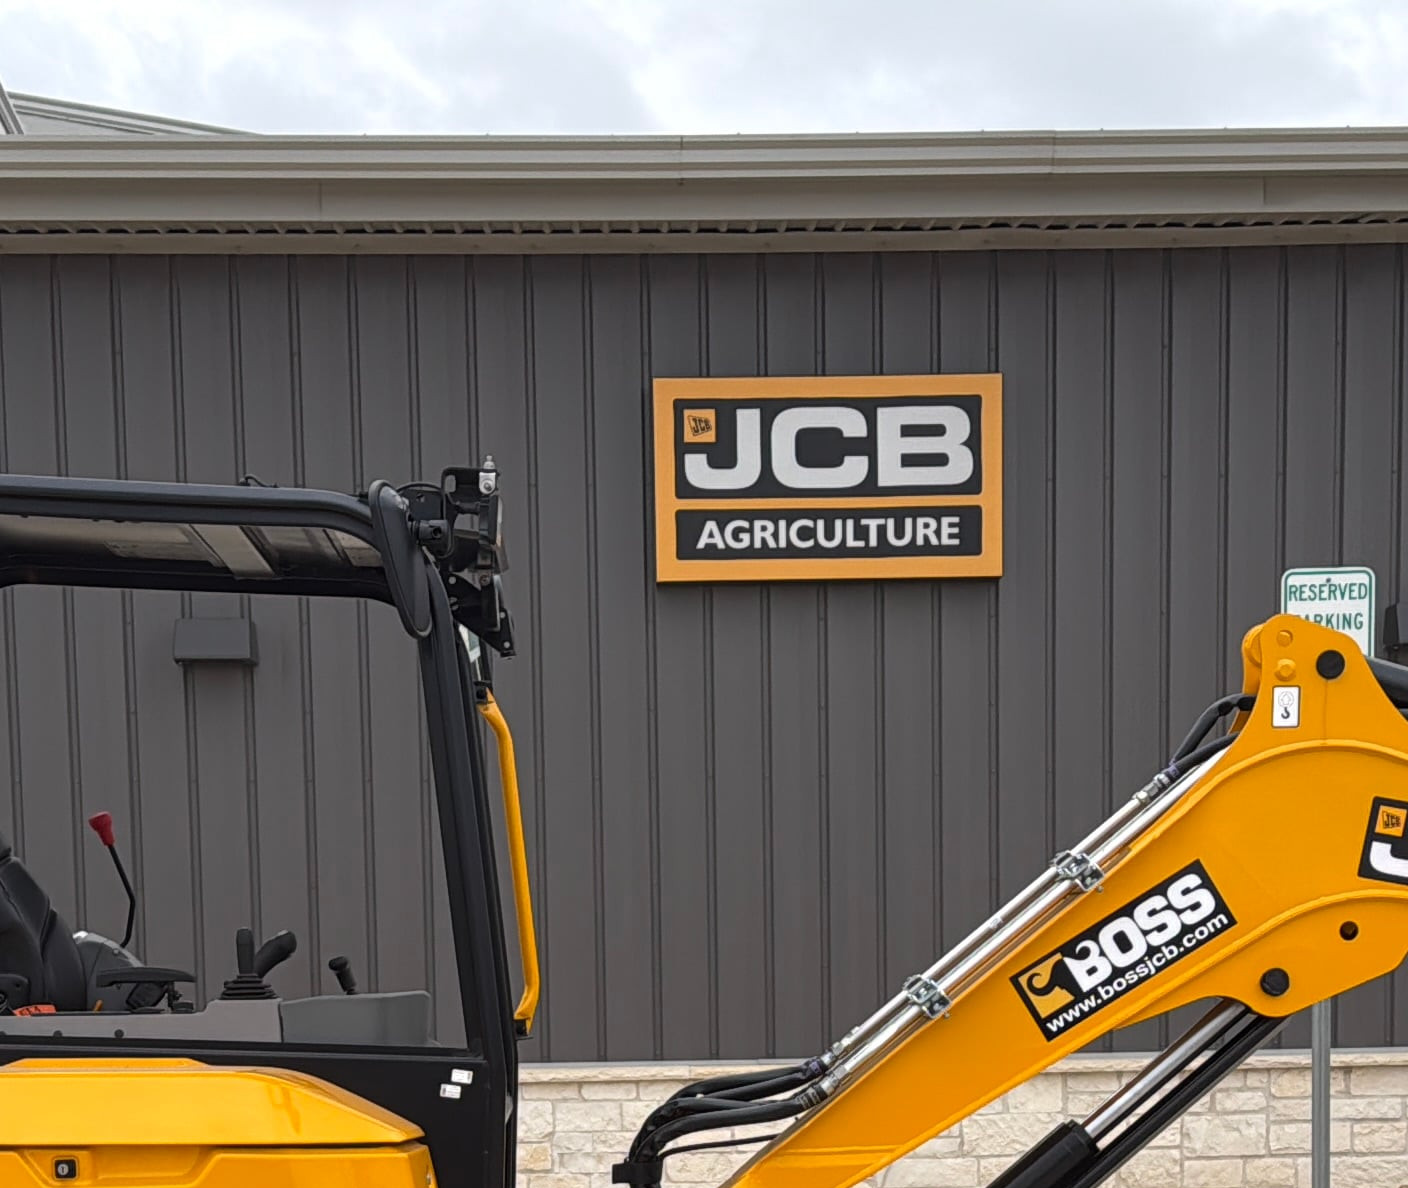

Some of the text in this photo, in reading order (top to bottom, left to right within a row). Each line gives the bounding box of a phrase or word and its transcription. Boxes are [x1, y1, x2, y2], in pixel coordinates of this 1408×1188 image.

[684, 405, 974, 490] JCB
[696, 516, 961, 550] AGRICULTURE
[1288, 582, 1368, 602] RESERVED
[1045, 913, 1229, 1033] www.bossjcb.com
[1063, 873, 1216, 993] BOSS
